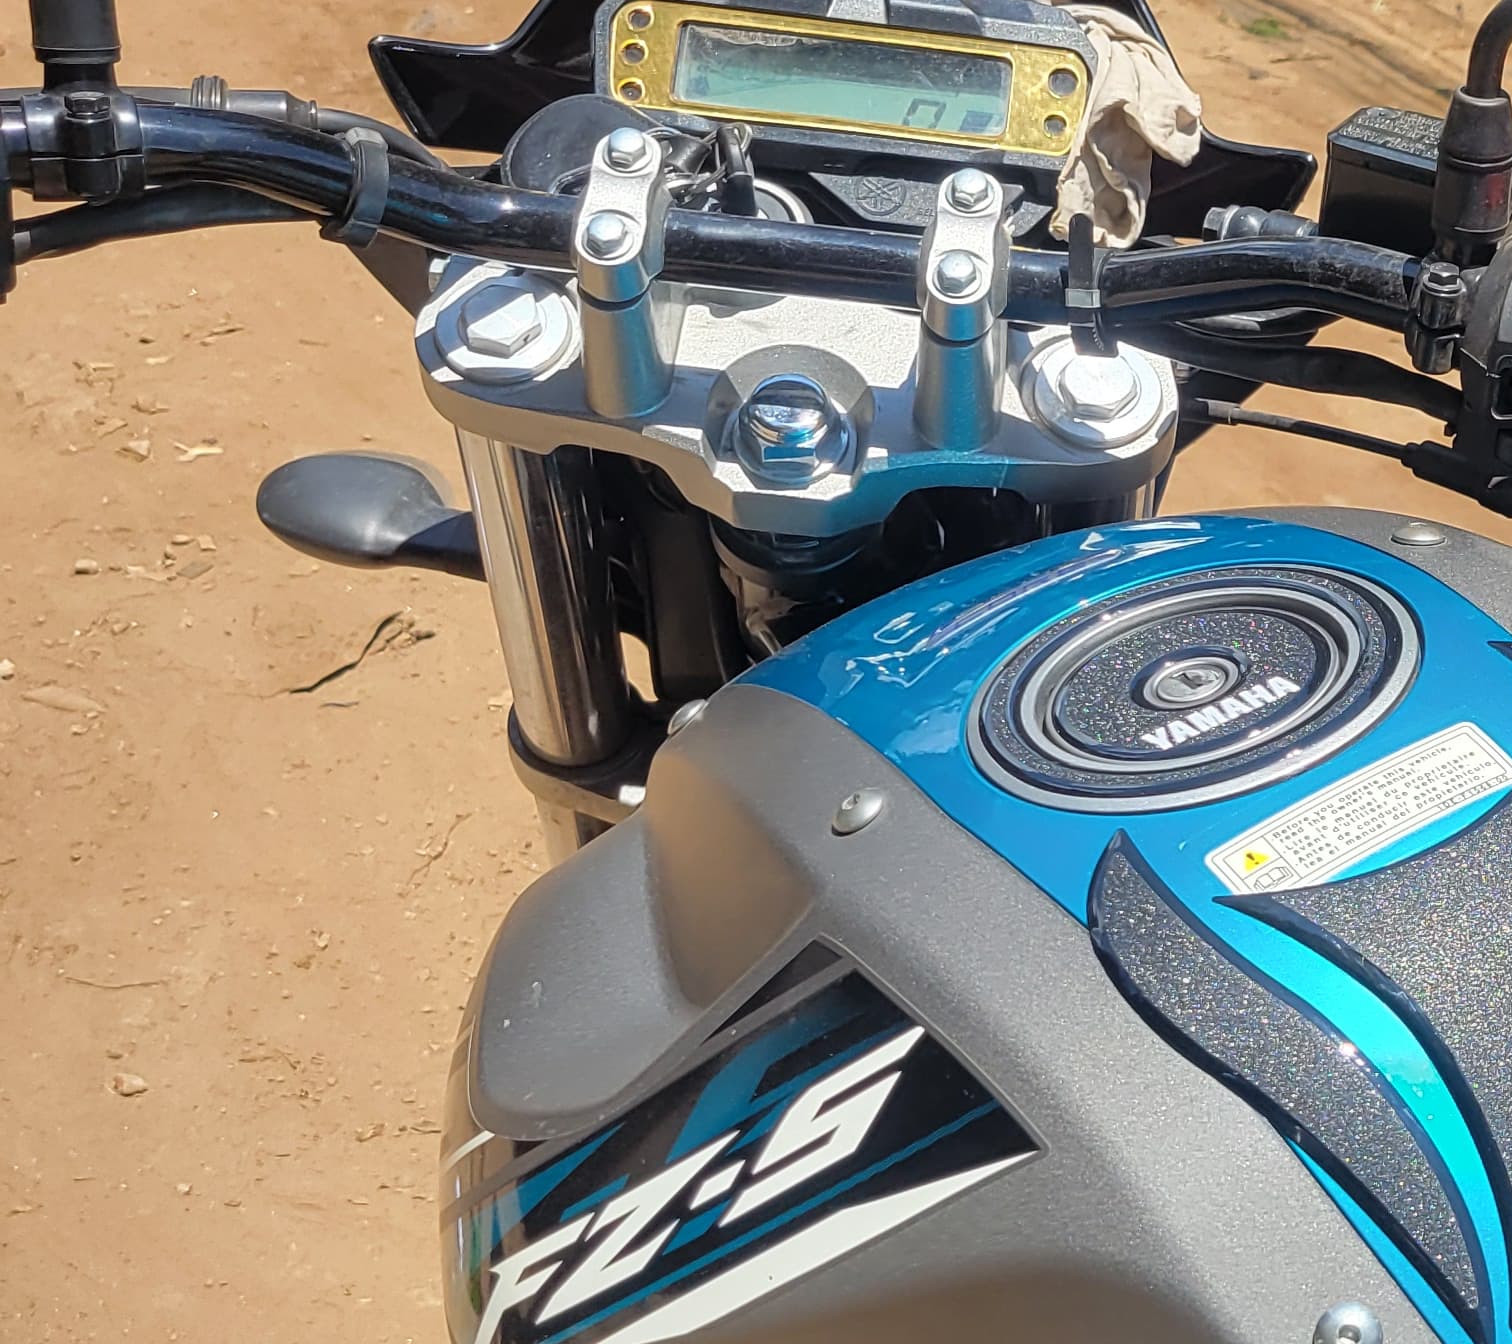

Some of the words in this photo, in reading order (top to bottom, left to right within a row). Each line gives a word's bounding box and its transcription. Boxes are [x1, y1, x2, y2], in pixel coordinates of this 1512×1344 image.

[1141, 676, 1301, 751] YAMAHA
[1272, 816, 1310, 839] Before
[1313, 803, 1335, 817] you
[1338, 779, 1379, 803] operate
[1382, 767, 1405, 780] this
[1279, 826, 1305, 844] read
[1307, 814, 1327, 827] the
[1330, 790, 1374, 815] owner's
[1284, 835, 1311, 851] Lire
[1334, 797, 1378, 824] manuel
[1297, 842, 1332, 864] Antes
[1356, 801, 1407, 830] conducir
[1413, 786, 1438, 801] este
[1292, 833, 1327, 856] avant
[1303, 856, 1324, 869] lea
[1345, 820, 1387, 846] manual
[1392, 807, 1411, 821] del
